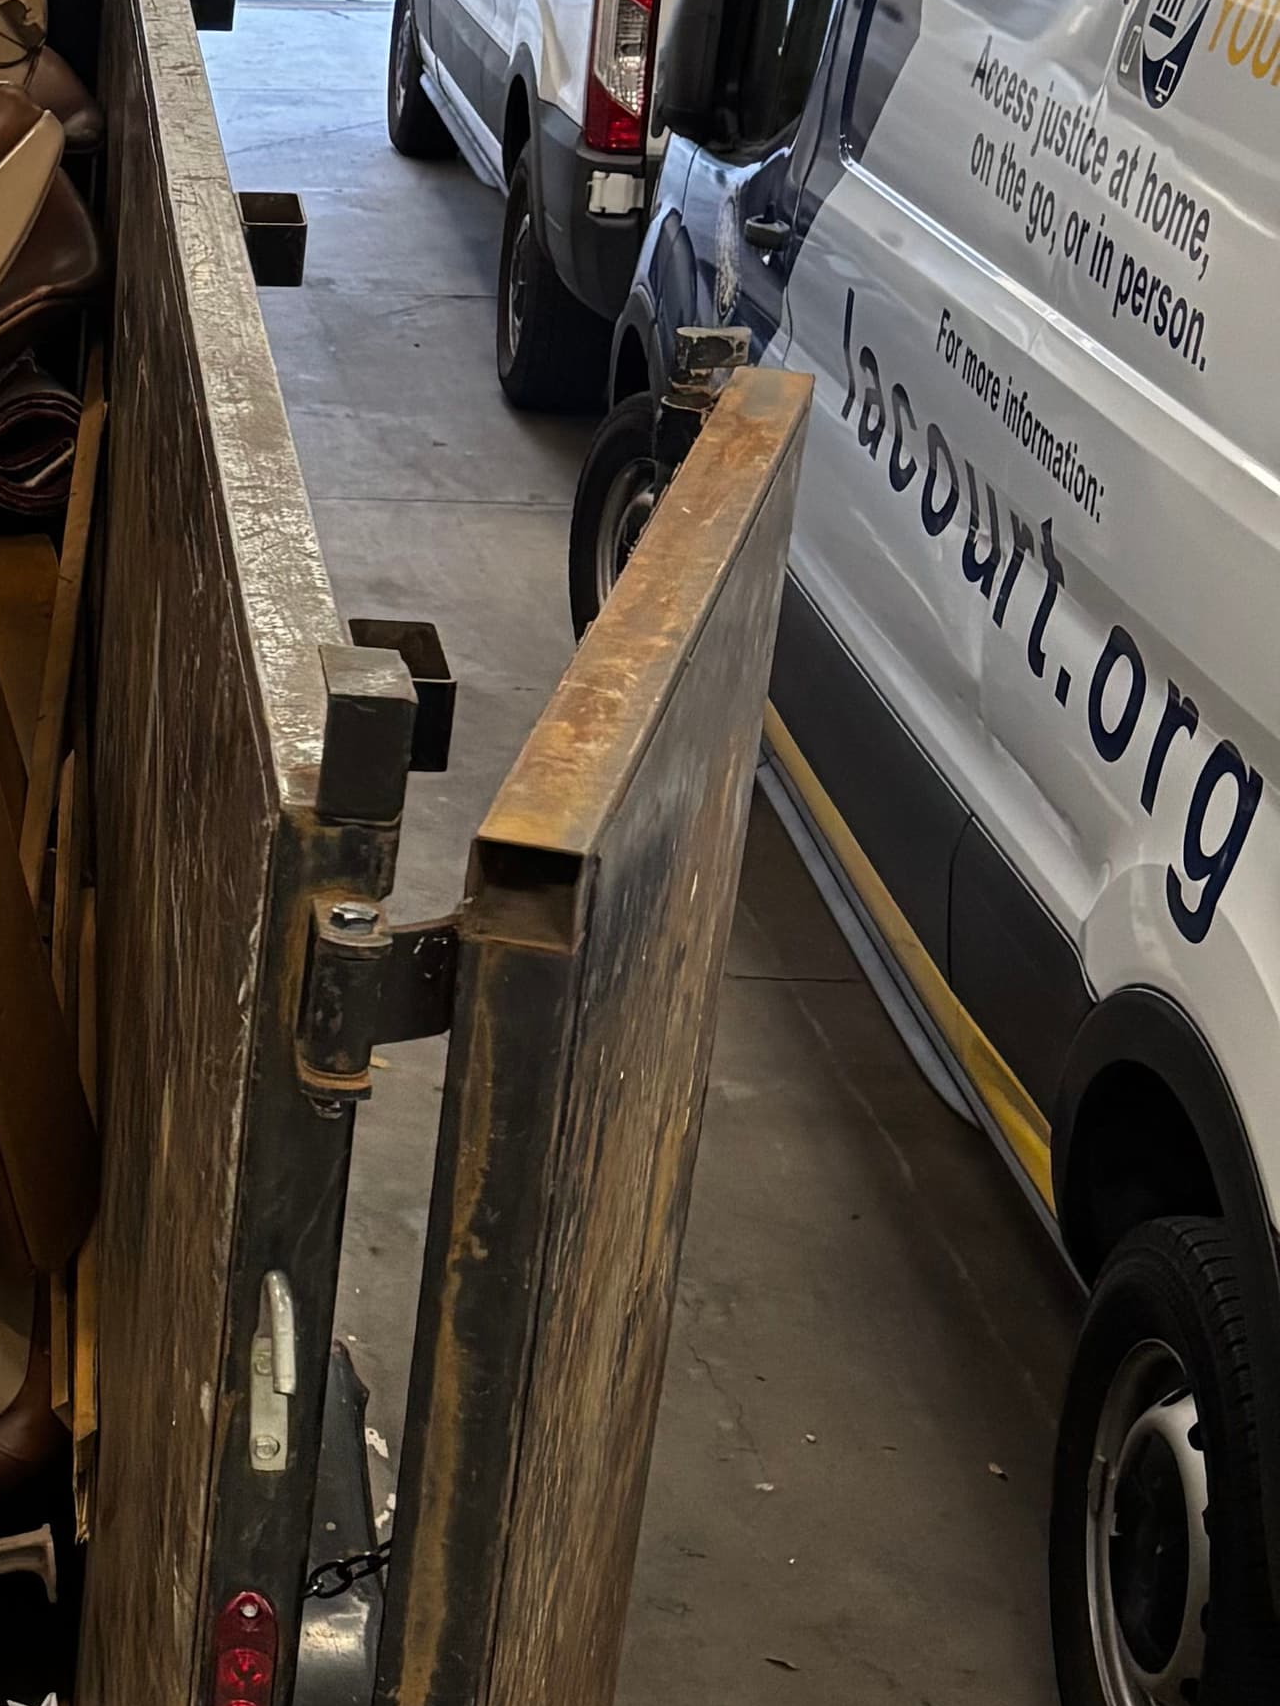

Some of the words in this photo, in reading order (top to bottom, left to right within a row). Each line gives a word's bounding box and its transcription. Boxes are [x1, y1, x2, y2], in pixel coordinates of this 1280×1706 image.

[970, 132, 995, 187] on
[995, 141, 1027, 214] the
[1025, 180, 1057, 255] go,
[1063, 211, 1090, 265] or
[1089, 213, 1114, 289] in
[1112, 253, 1207, 372] person.
[971, 34, 1038, 132] Access
[1030, 80, 1109, 186] justice
[1108, 145, 1141, 209] at
[1135, 151, 1210, 280] home,
[936, 308, 962, 369] For
[962, 346, 1000, 412] more
[1003, 375, 1104, 523] information:
[839, 287, 1265, 944] lacourt.org
